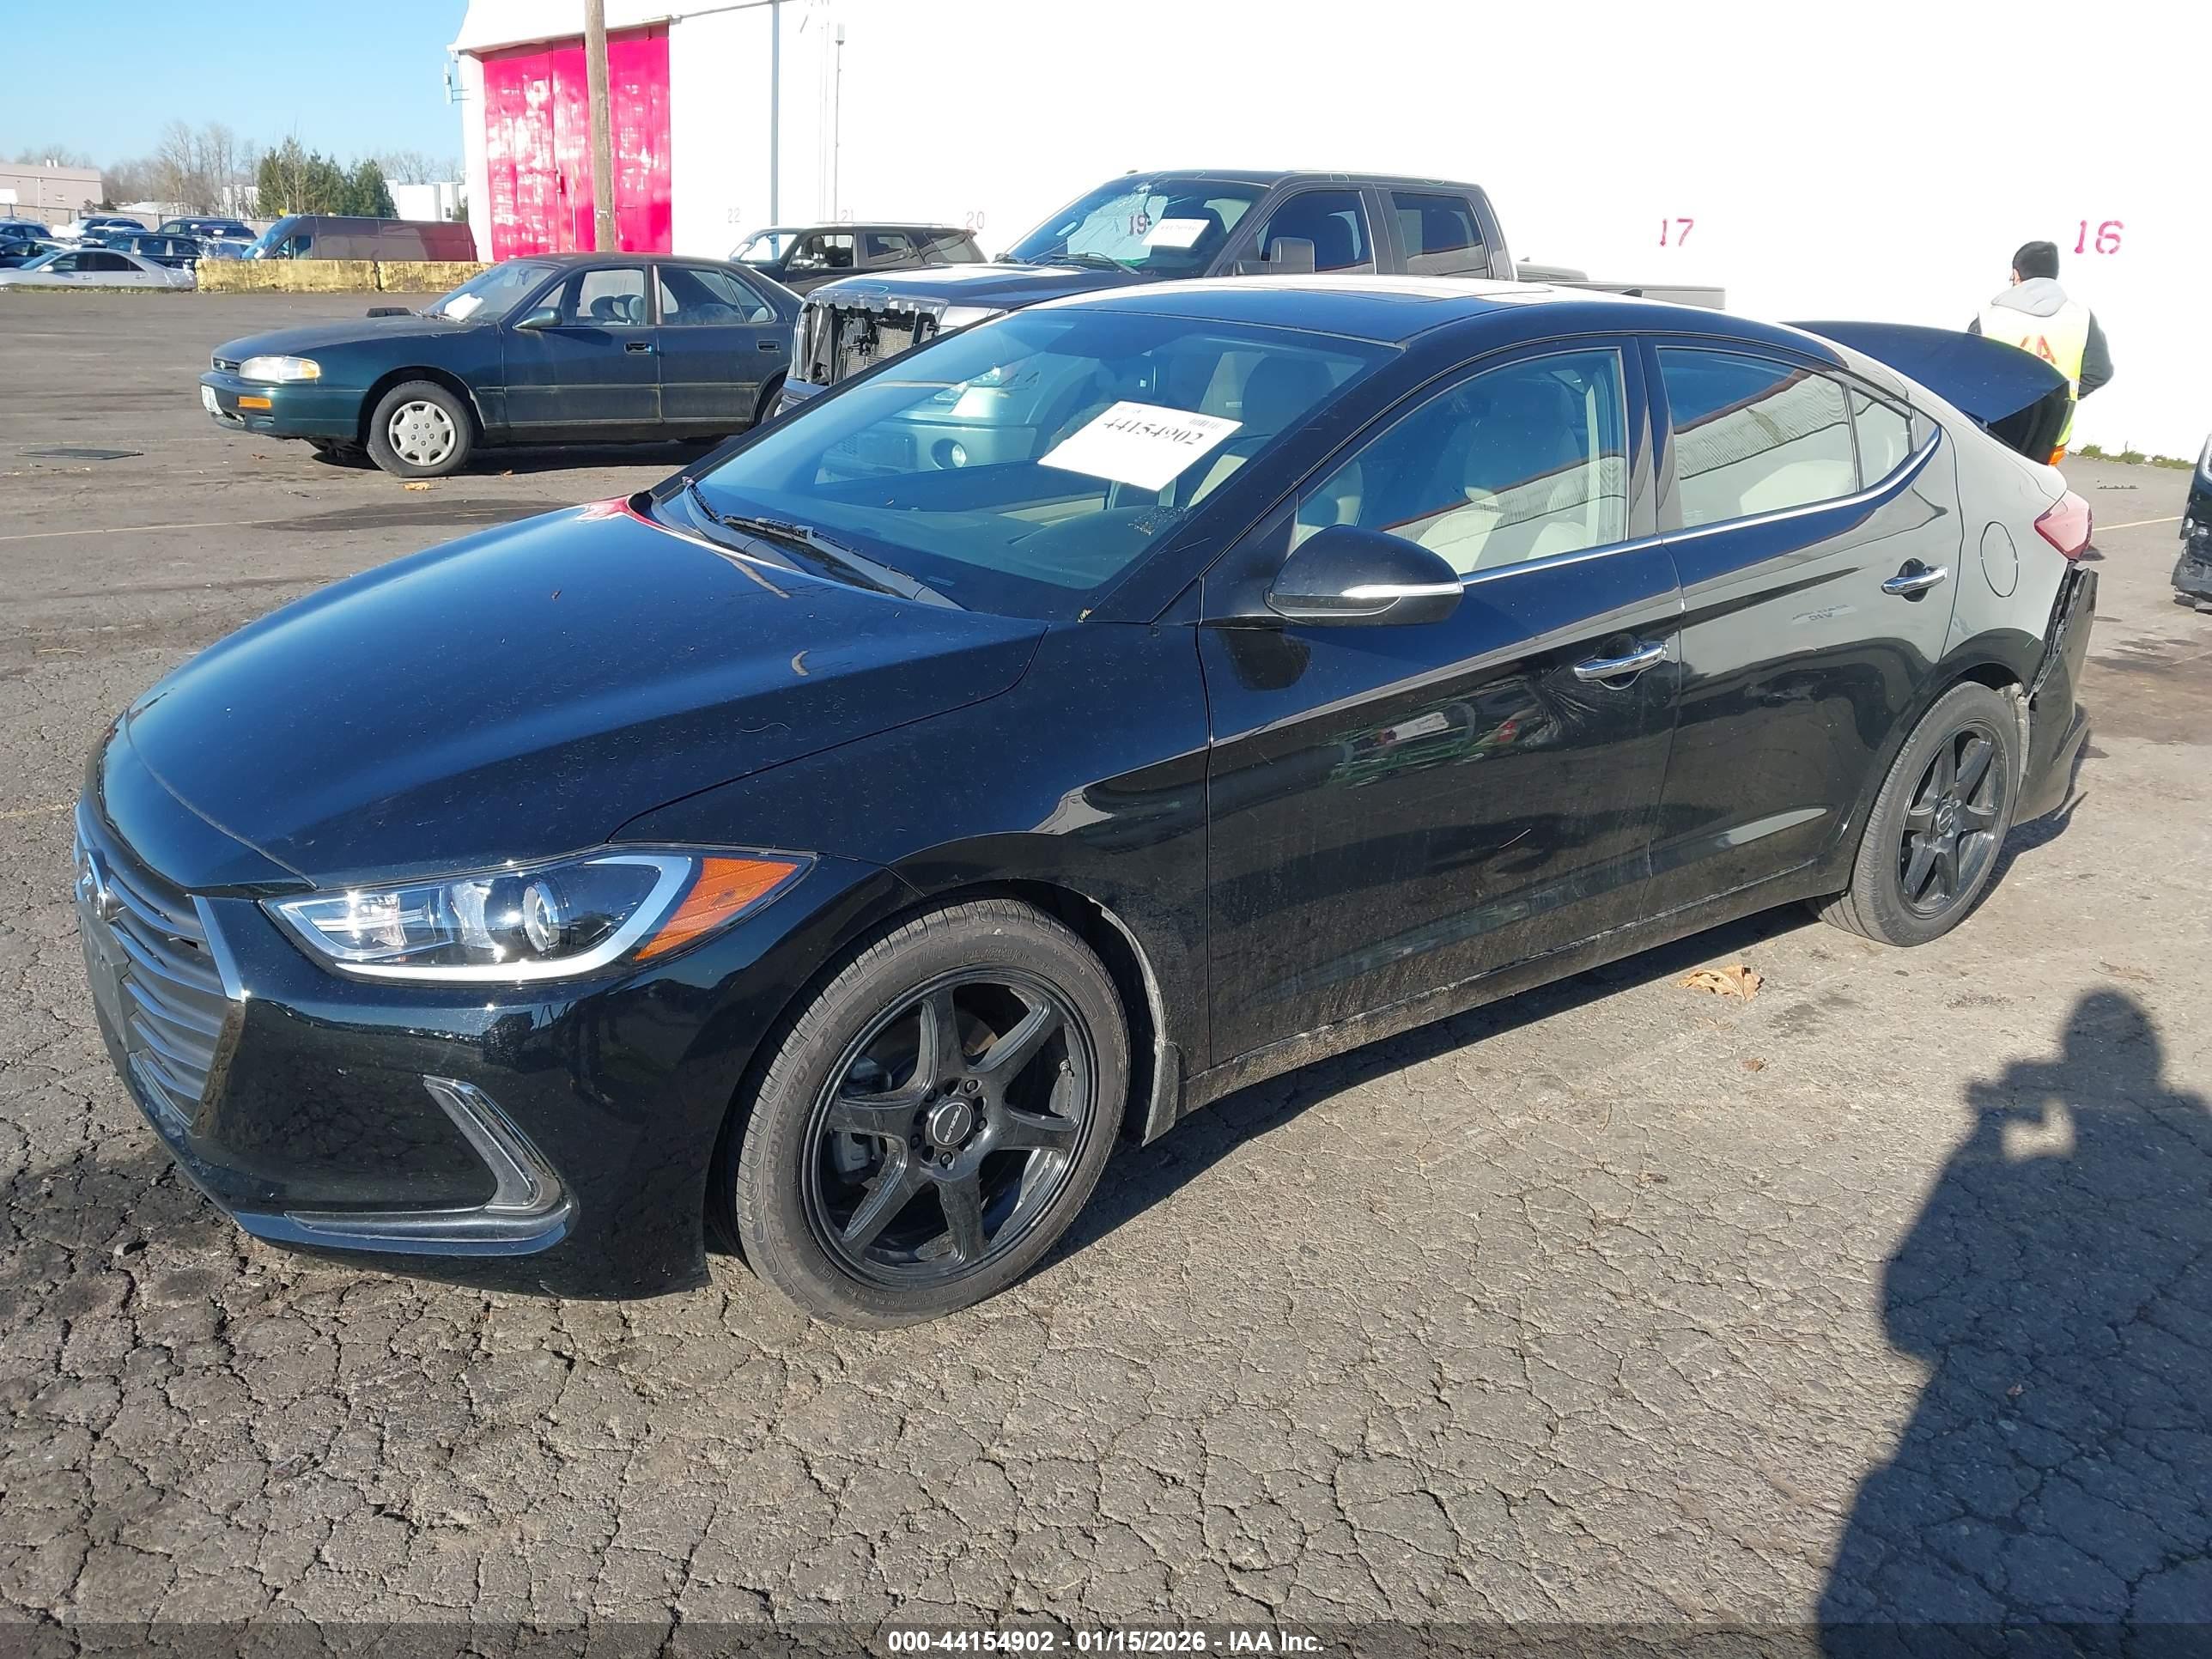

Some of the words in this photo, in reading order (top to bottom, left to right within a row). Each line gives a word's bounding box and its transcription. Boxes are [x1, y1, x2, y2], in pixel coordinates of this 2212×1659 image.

[966, 211, 985, 229] 20
[1127, 214, 1147, 236] 19
[1660, 218, 1694, 247] 17
[2075, 220, 2124, 255] 16
[1104, 417, 1204, 445] 44154902
